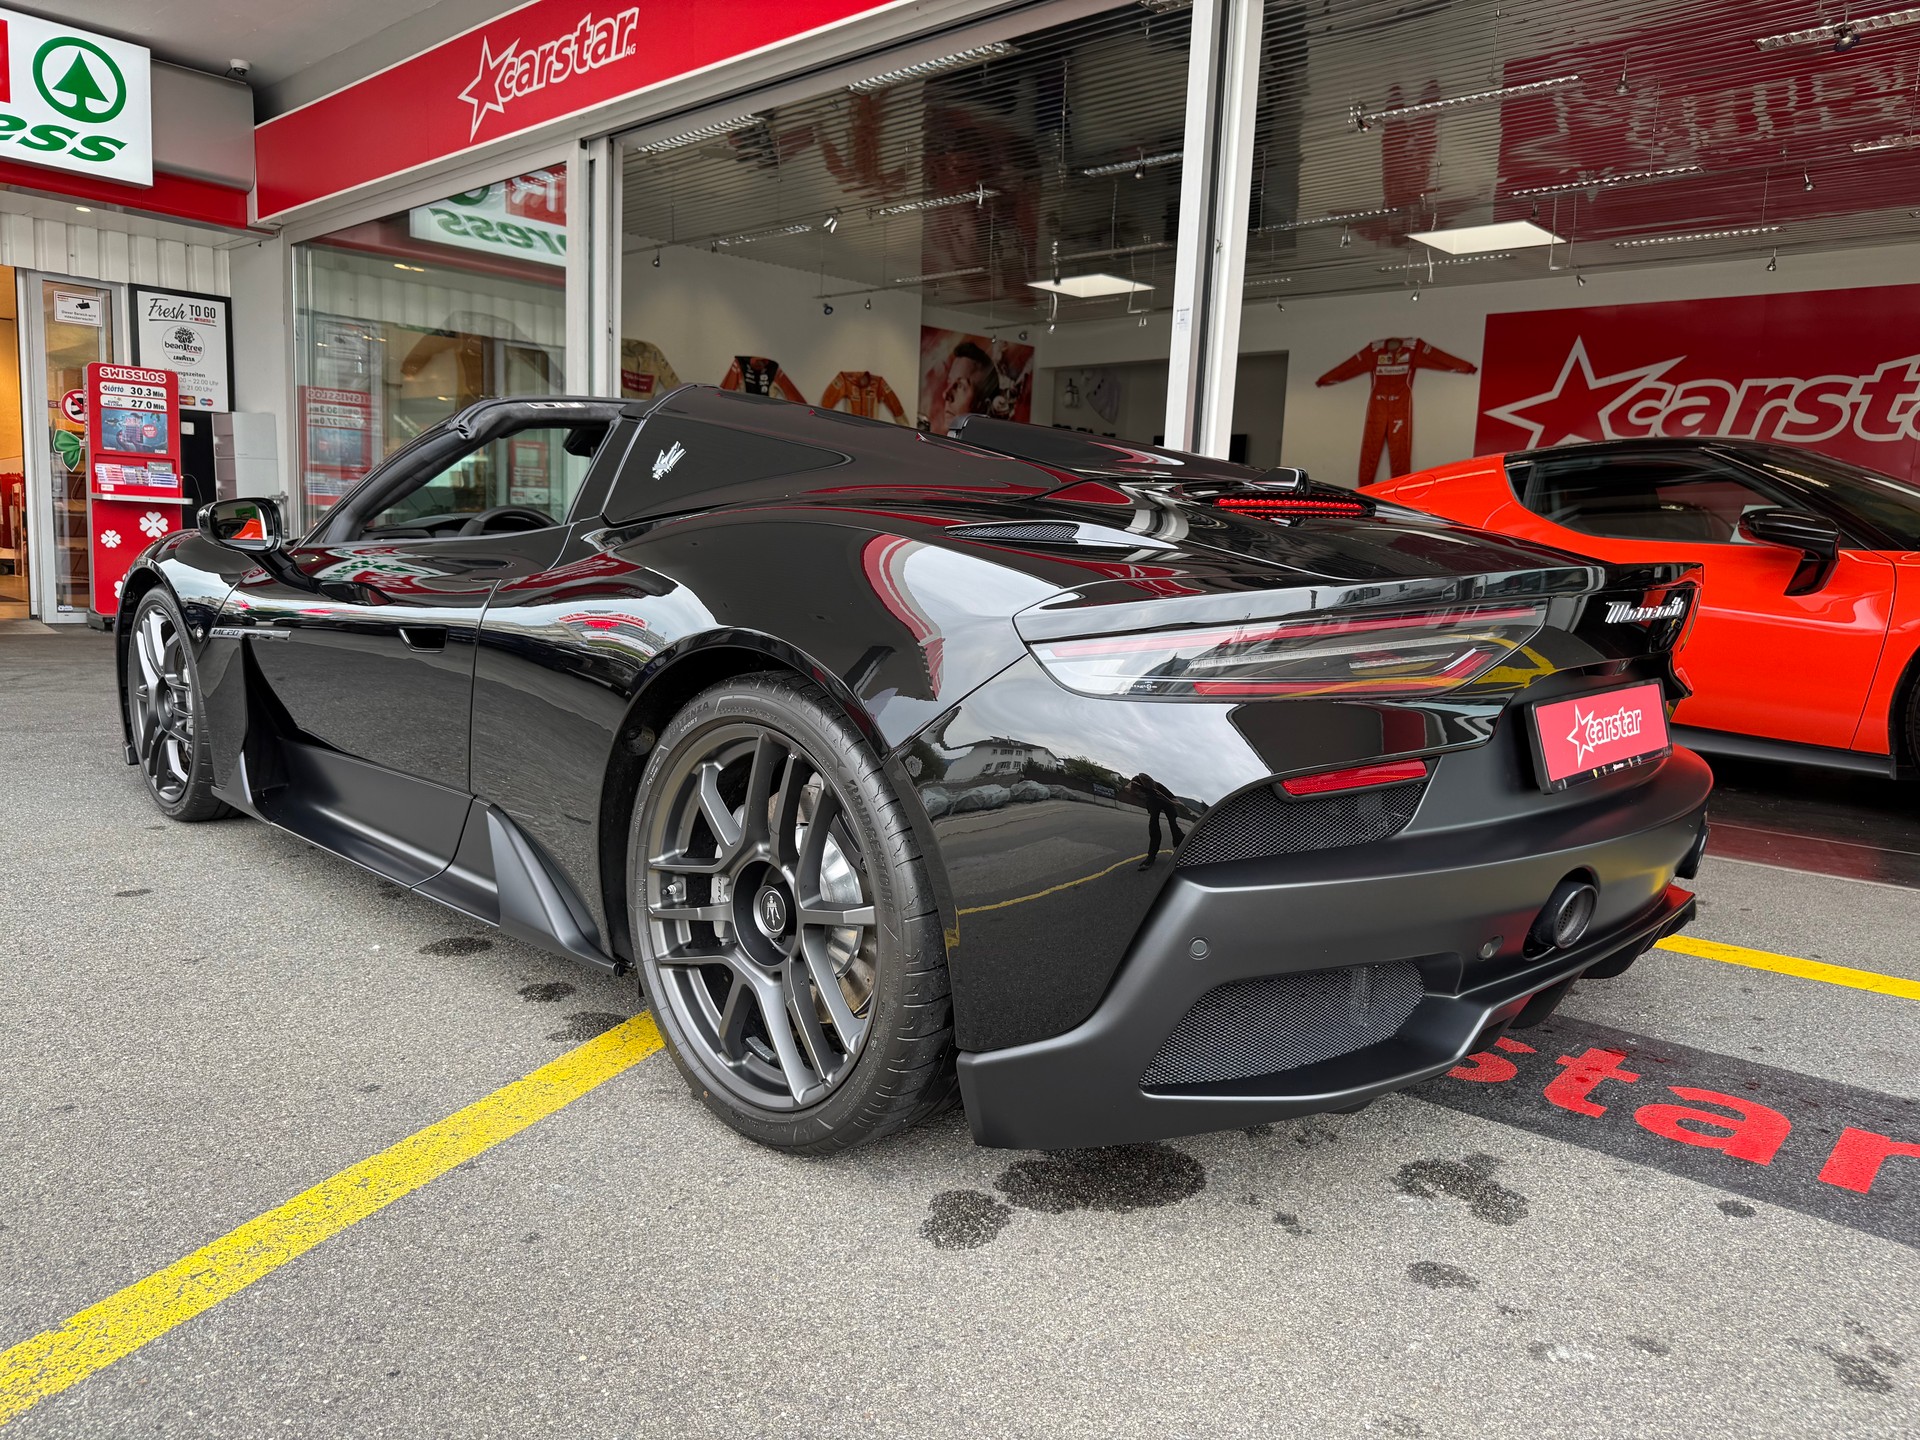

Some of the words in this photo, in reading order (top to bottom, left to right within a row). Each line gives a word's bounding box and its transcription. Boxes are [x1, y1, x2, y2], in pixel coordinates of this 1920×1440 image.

[499, 7, 639, 103] carstar
[625, 43, 636, 57] AG
[148, 298, 187, 320] Fresh
[188, 304, 201, 317] TO
[203, 306, 216, 319] GO
[100, 367, 166, 383] SWISSLOS
[131, 387, 152, 396] 30.3
[1598, 355, 1920, 442] carst
[131, 400, 153, 409] 27.0
[1393, 420, 1403, 433] 7
[212, 629, 240, 637] MC20
[680, 717, 698, 733] SPORT
[1585, 706, 1641, 747] carstar
